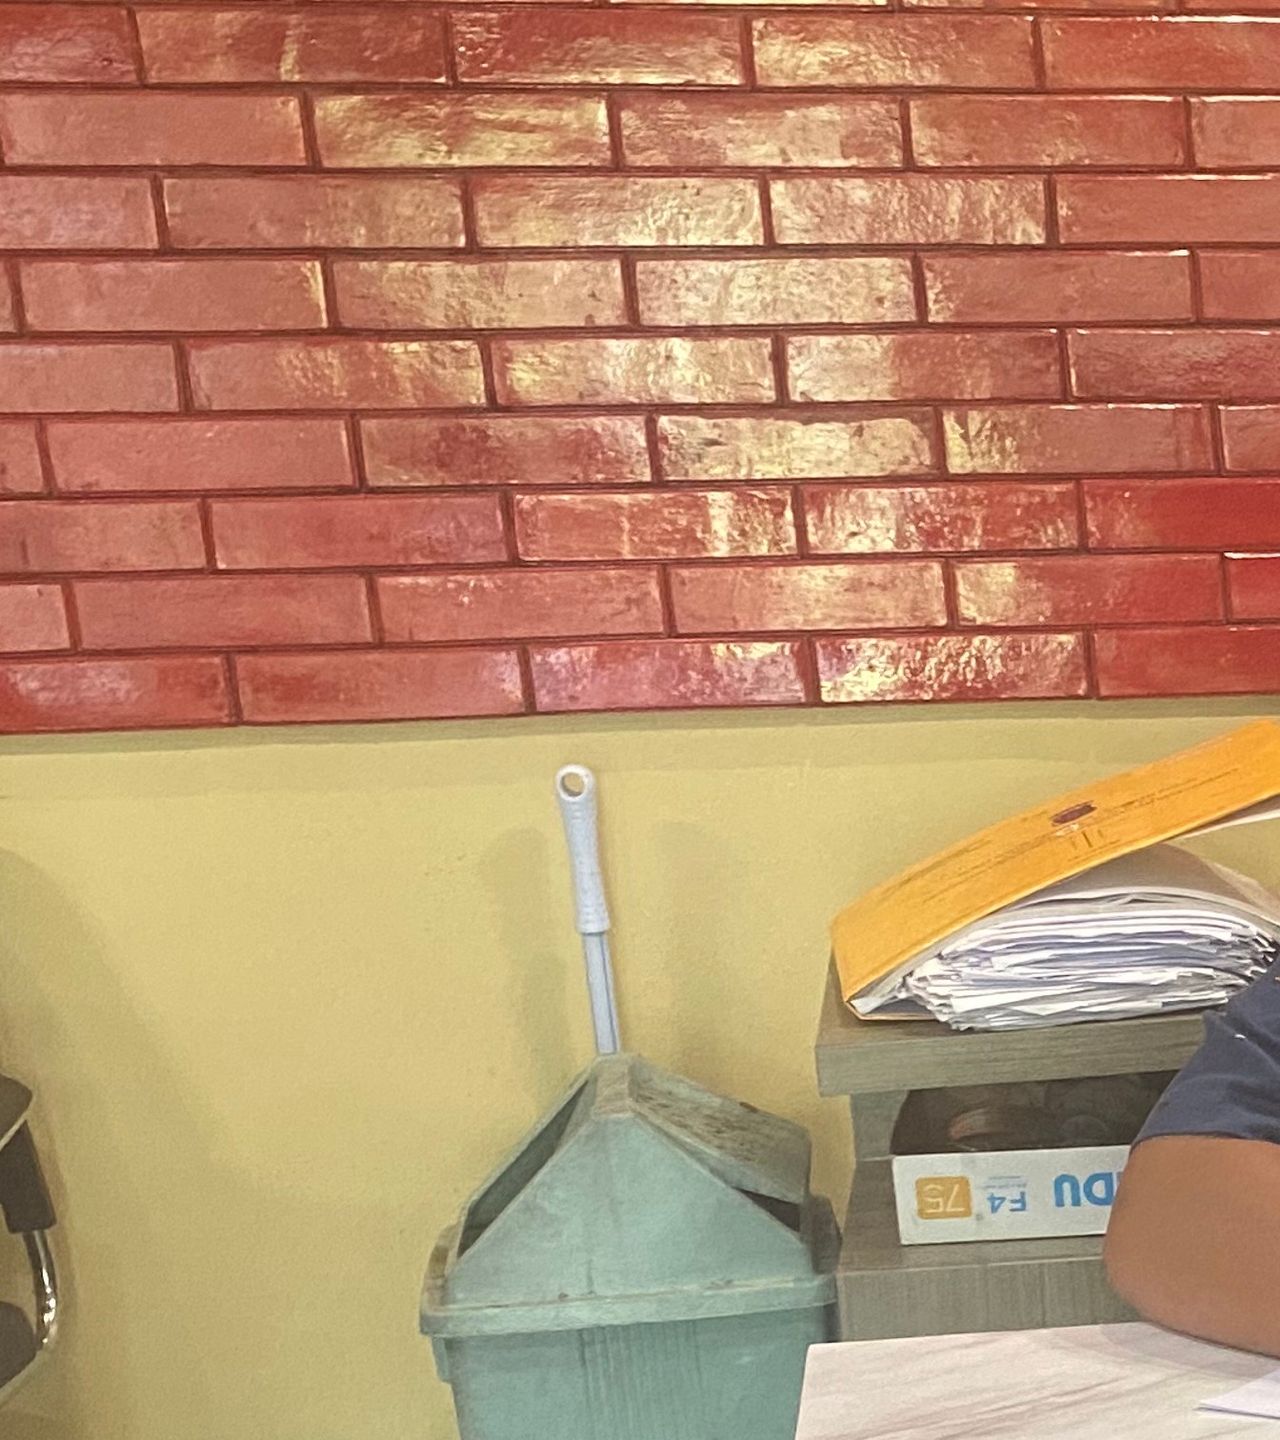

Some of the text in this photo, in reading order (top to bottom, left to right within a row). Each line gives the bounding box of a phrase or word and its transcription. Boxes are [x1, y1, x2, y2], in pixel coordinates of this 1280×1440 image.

[923, 1183, 965, 1214] 75
[986, 1191, 1027, 1214] F4
[1054, 1171, 1123, 1207] DU
